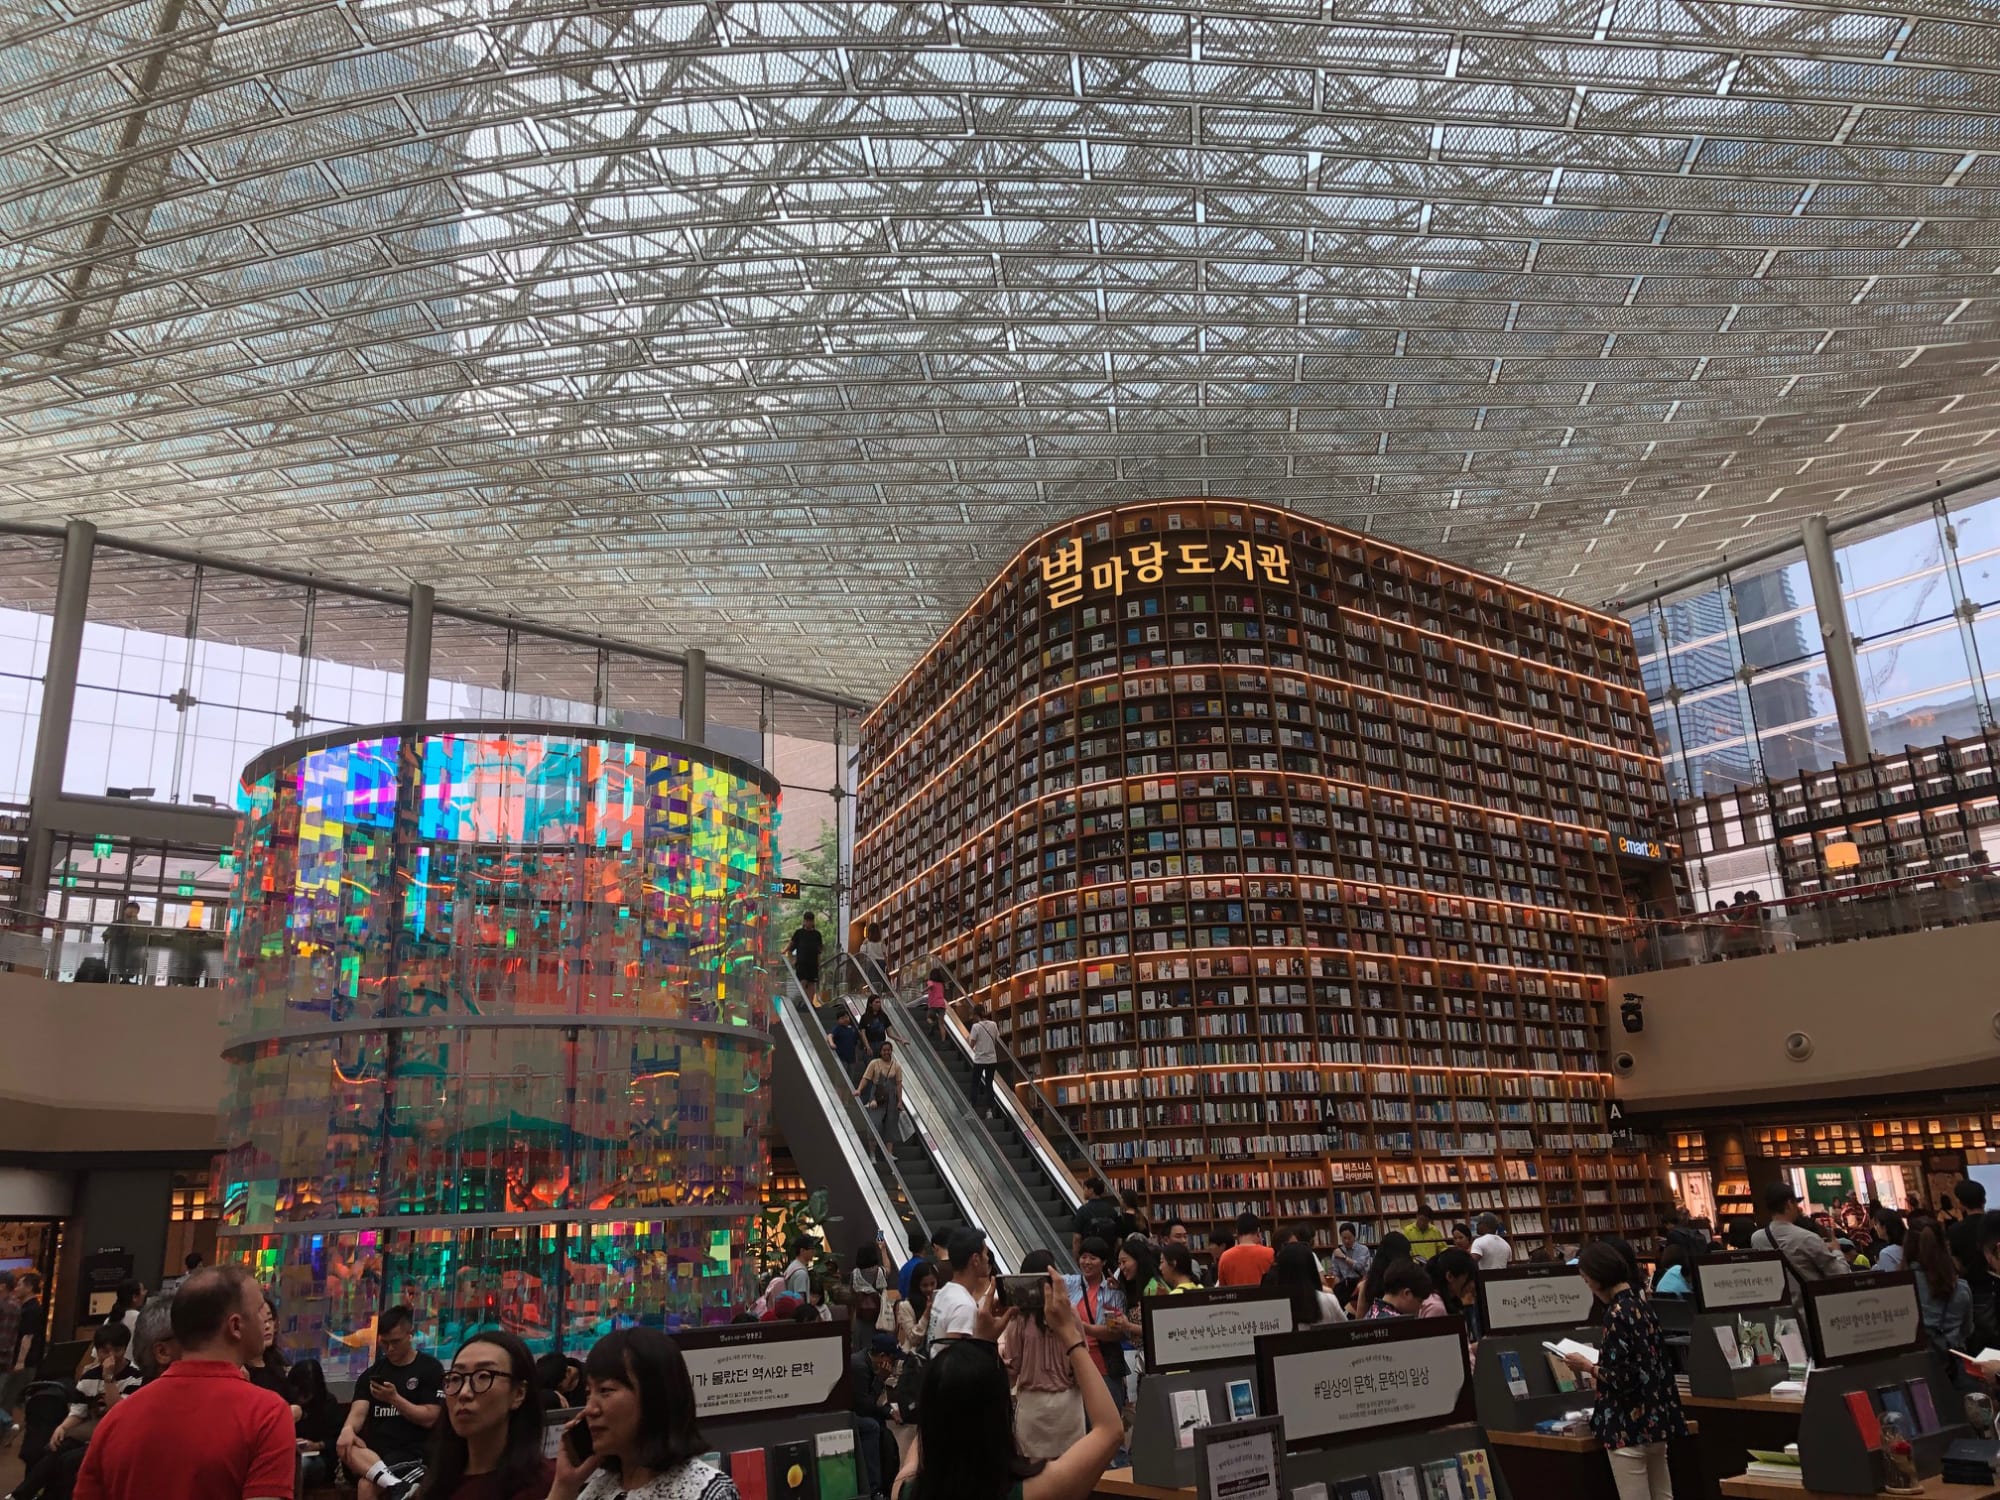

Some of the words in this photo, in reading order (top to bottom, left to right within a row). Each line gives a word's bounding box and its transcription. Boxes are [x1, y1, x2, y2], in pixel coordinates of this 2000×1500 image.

[1039, 537, 1169, 610] 별마당
[1176, 540, 1291, 585] 도서관
[1619, 836, 1661, 859] emart24
[1326, 1099, 1335, 1117] A
[1610, 1103, 1622, 1119] A
[1343, 1162, 1372, 1172] 비즈니스
[1207, 1323, 1227, 1339] 빛나는
[1228, 1324, 1237, 1336] 내
[1237, 1320, 1258, 1335] 인생을
[690, 1371, 708, 1388] 가
[711, 1368, 749, 1386] 몰랐던
[752, 1364, 789, 1382] 역사와
[791, 1361, 814, 1378] 문학
[1314, 1376, 1353, 1400] #일상의
[1354, 1373, 1377, 1395] 문학,
[1378, 1369, 1410, 1392] 문학의
[1409, 1366, 1430, 1387] 일상
